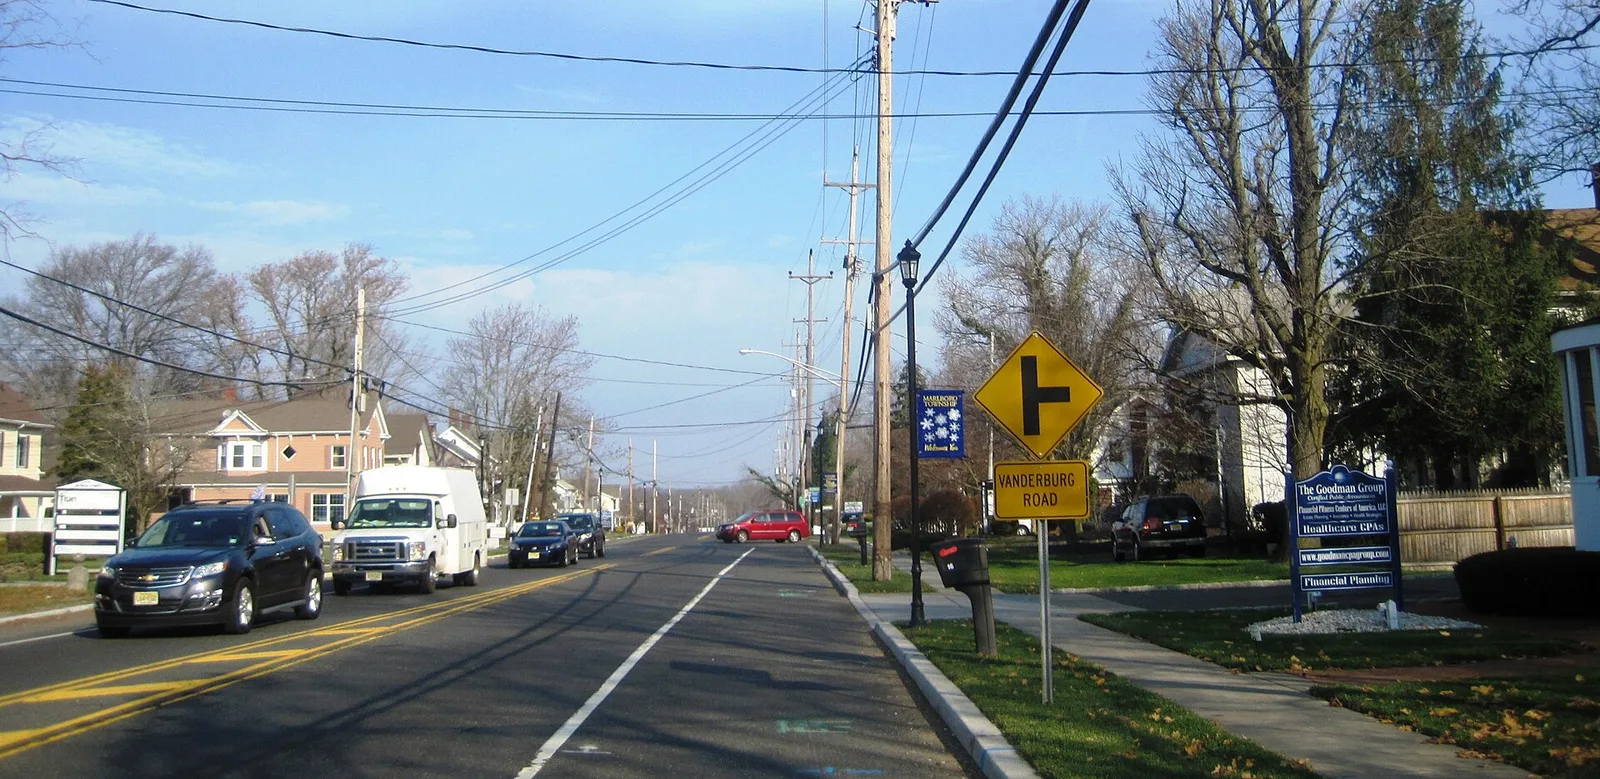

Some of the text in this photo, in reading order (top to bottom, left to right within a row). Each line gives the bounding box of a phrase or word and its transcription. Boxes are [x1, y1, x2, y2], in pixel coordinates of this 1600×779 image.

[998, 473, 1075, 488] VANDERBURG
[1298, 482, 1384, 495] The Goodman Group
[1023, 492, 1058, 507] ROAD
[1299, 506, 1318, 514] Financial
[1303, 522, 1385, 534] Healthcare CPAs
[1301, 550, 1389, 562] www.goodmancpagroup.com
[1304, 574, 1390, 587] Financial Planning
